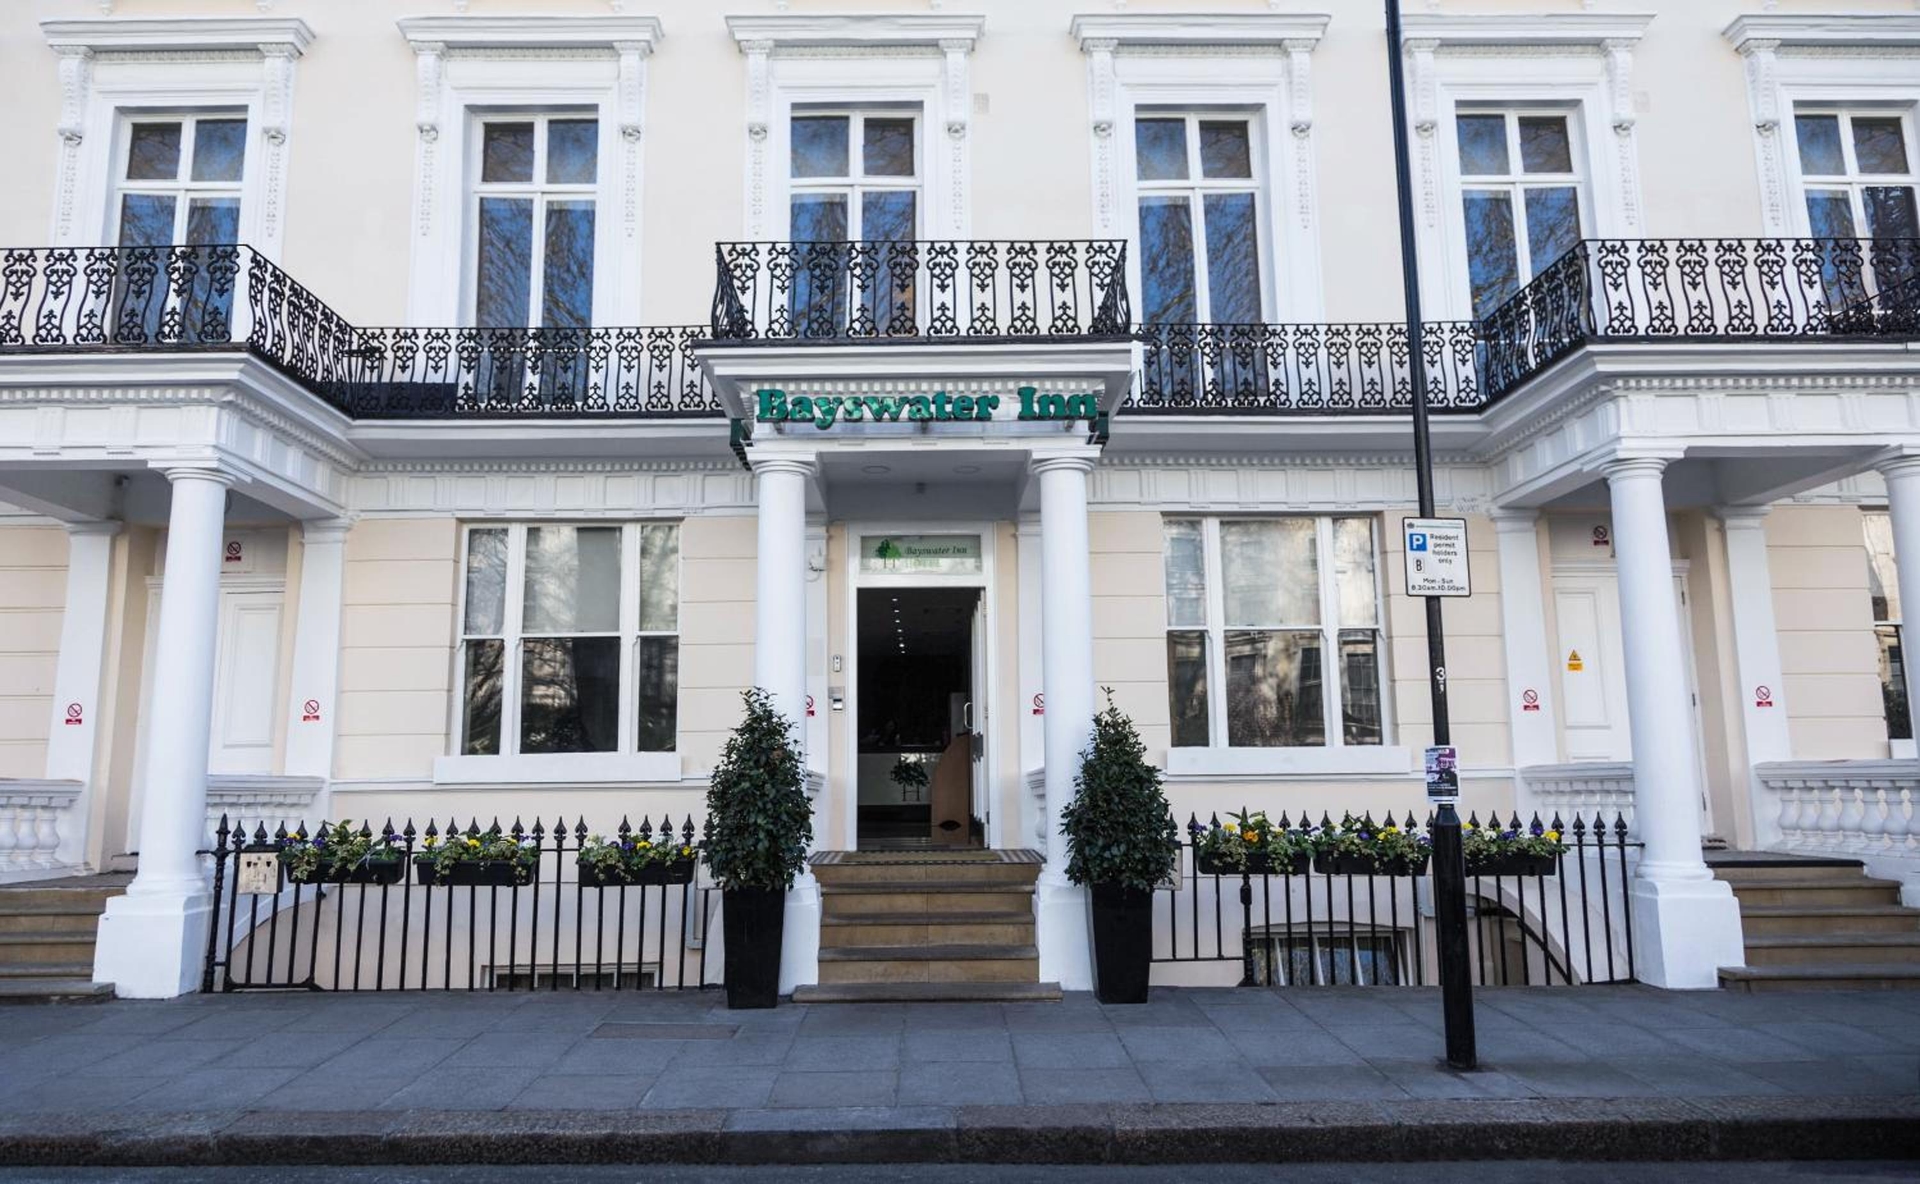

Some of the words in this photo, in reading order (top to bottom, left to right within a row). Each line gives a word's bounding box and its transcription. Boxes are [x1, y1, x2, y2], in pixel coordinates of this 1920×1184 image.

[756, 388, 999, 430] Bayswater
[1017, 386, 1098, 421] Inn
[1412, 535, 1424, 549] P
[1430, 533, 1458, 541] Resident
[906, 546, 950, 557] Bayswater
[952, 545, 967, 554] Inn
[1438, 557, 1452, 565] only
[1436, 666, 1446, 680] 3
